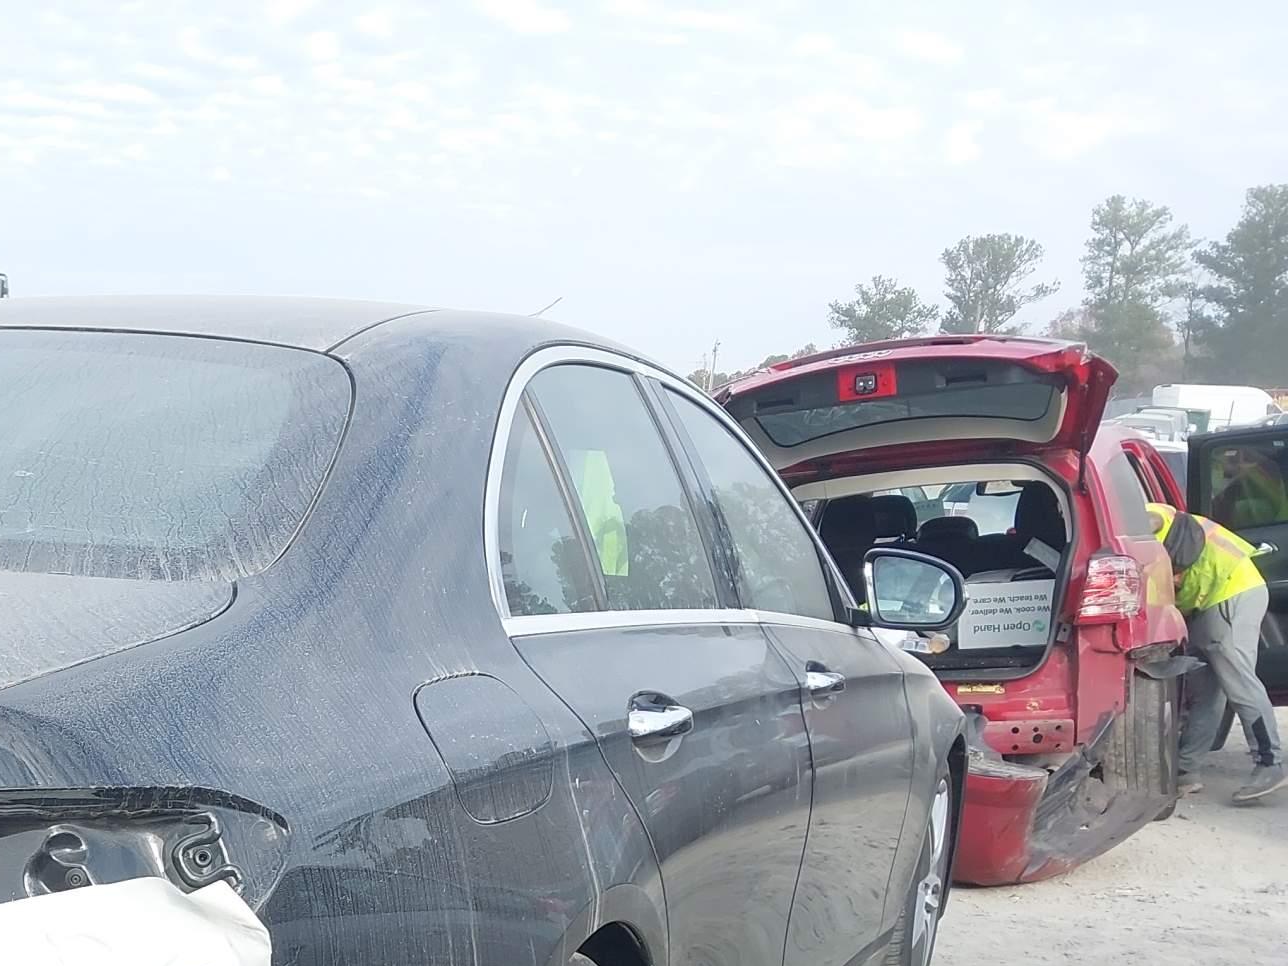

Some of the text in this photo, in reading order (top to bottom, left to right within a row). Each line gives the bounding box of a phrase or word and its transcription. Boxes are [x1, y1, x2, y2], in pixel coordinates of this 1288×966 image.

[993, 597, 1006, 605] We
[1007, 595, 1033, 604] teach.
[1034, 594, 1047, 602] We
[968, 608, 998, 616] deliver.
[999, 607, 1012, 615] We
[1037, 605, 1050, 613] We
[973, 621, 1031, 634] Open Hand
